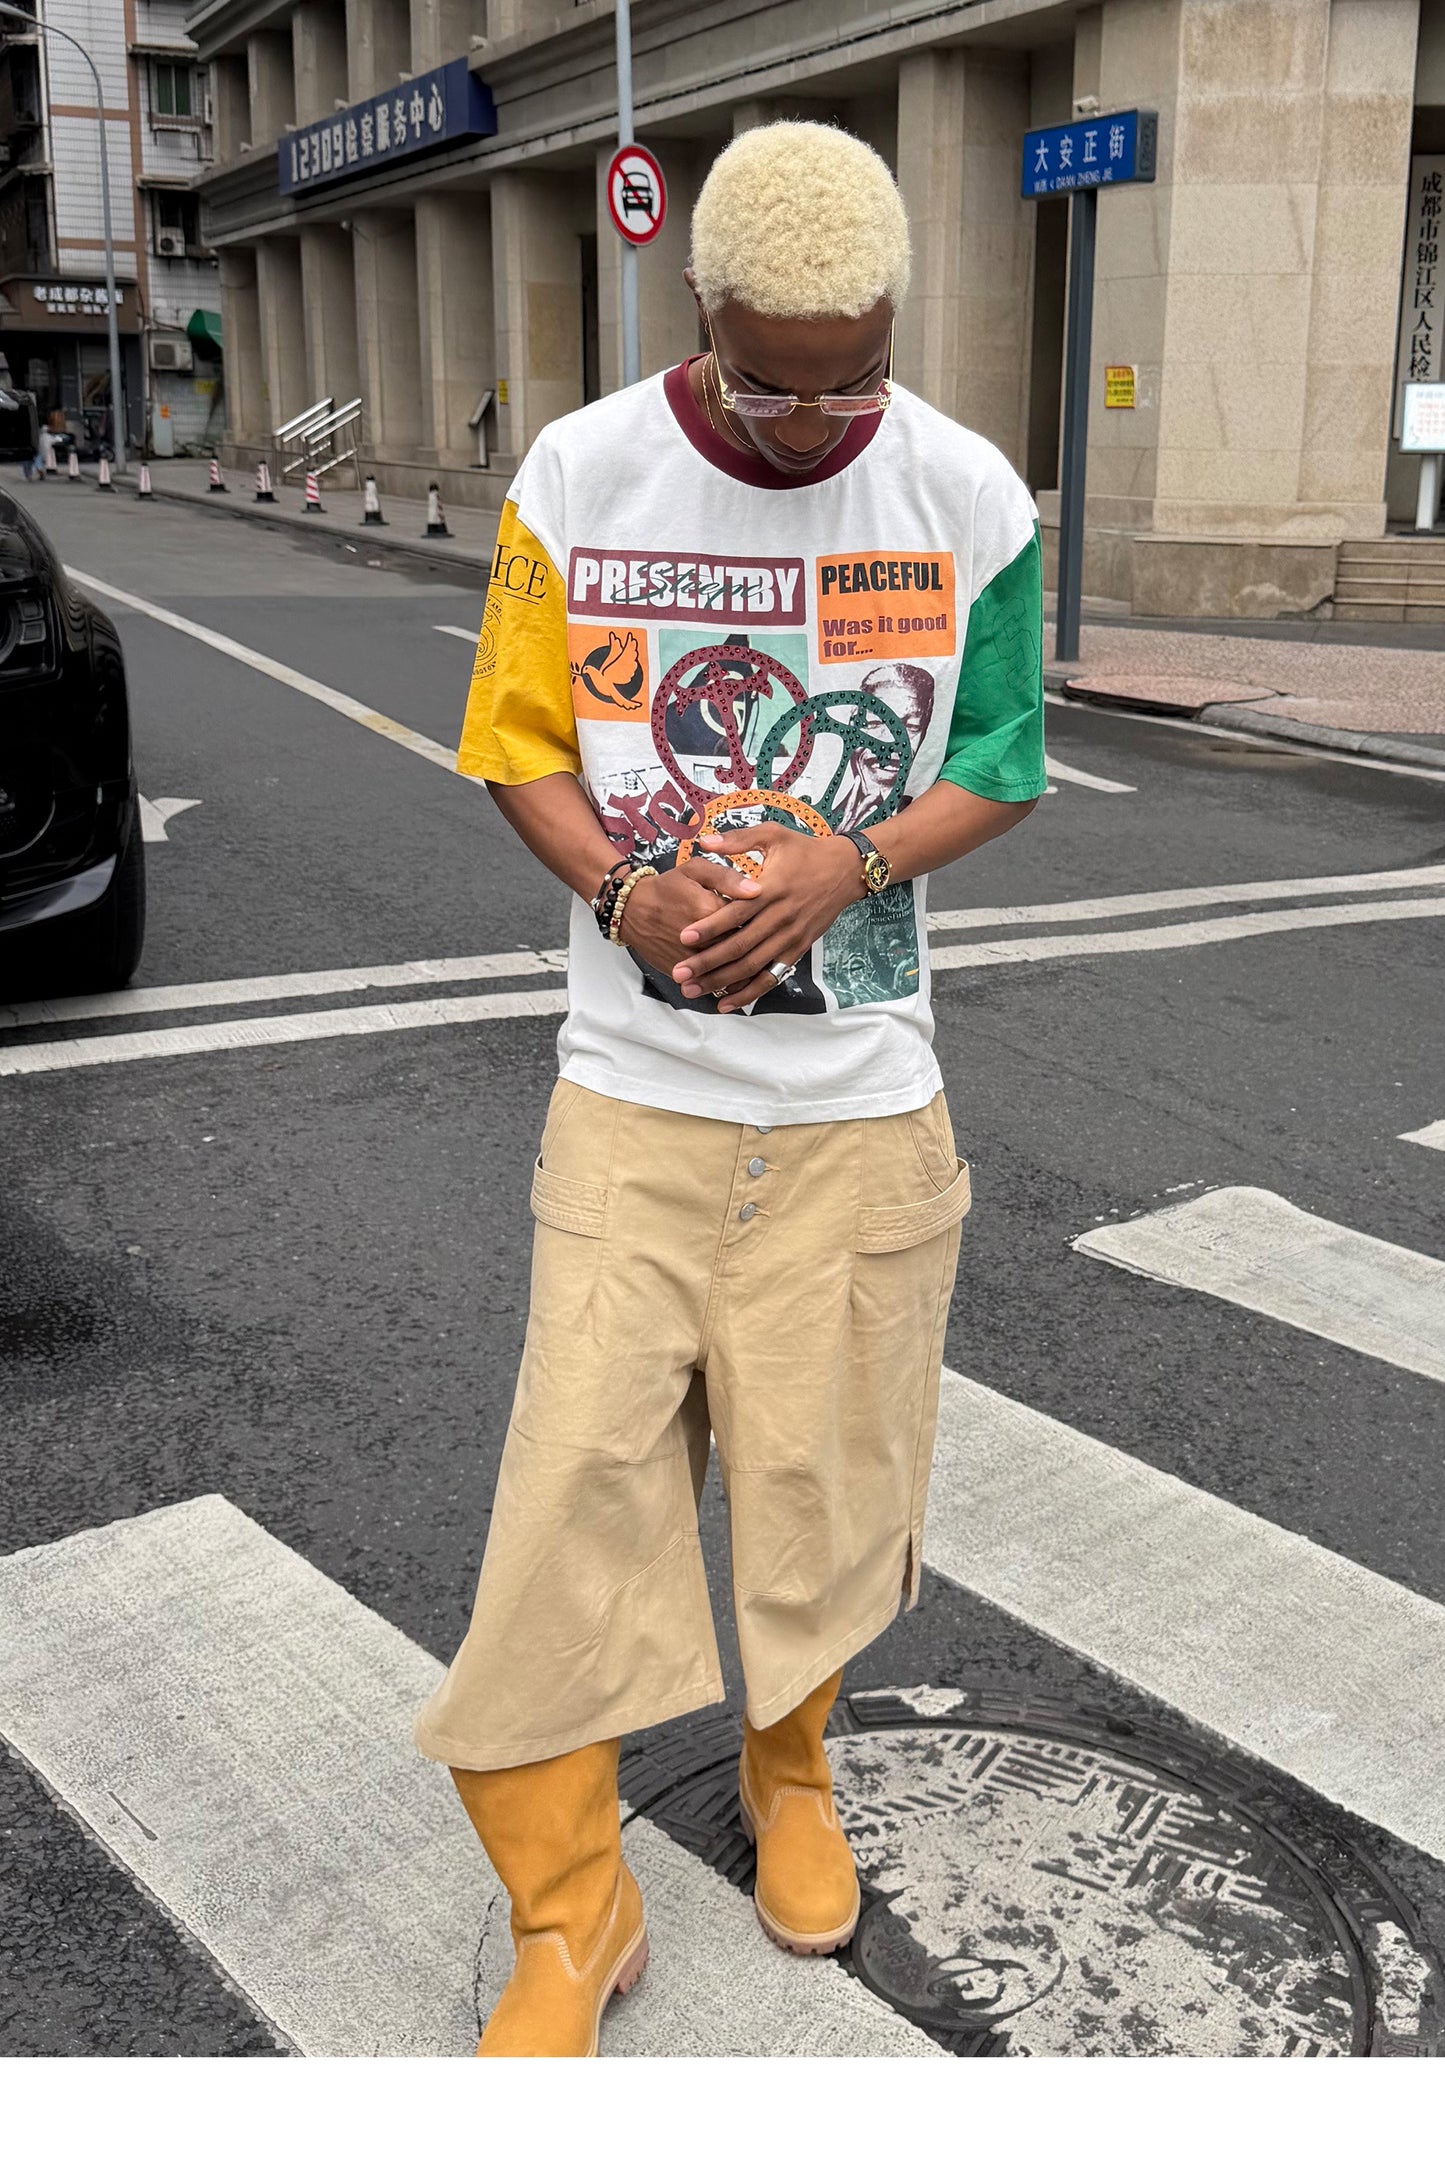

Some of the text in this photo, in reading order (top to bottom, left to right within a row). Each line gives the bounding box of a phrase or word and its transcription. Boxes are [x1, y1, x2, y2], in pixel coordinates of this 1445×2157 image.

[291, 83, 445, 184] 12309检察服务中心
[1033, 124, 1126, 173] 大安正街
[1409, 171, 1443, 382] 成都市锦江区人民检
[573, 557, 801, 613] PRESENTBY
[820, 560, 944, 596] PEACEFUL
[822, 613, 947, 638] Was it good
